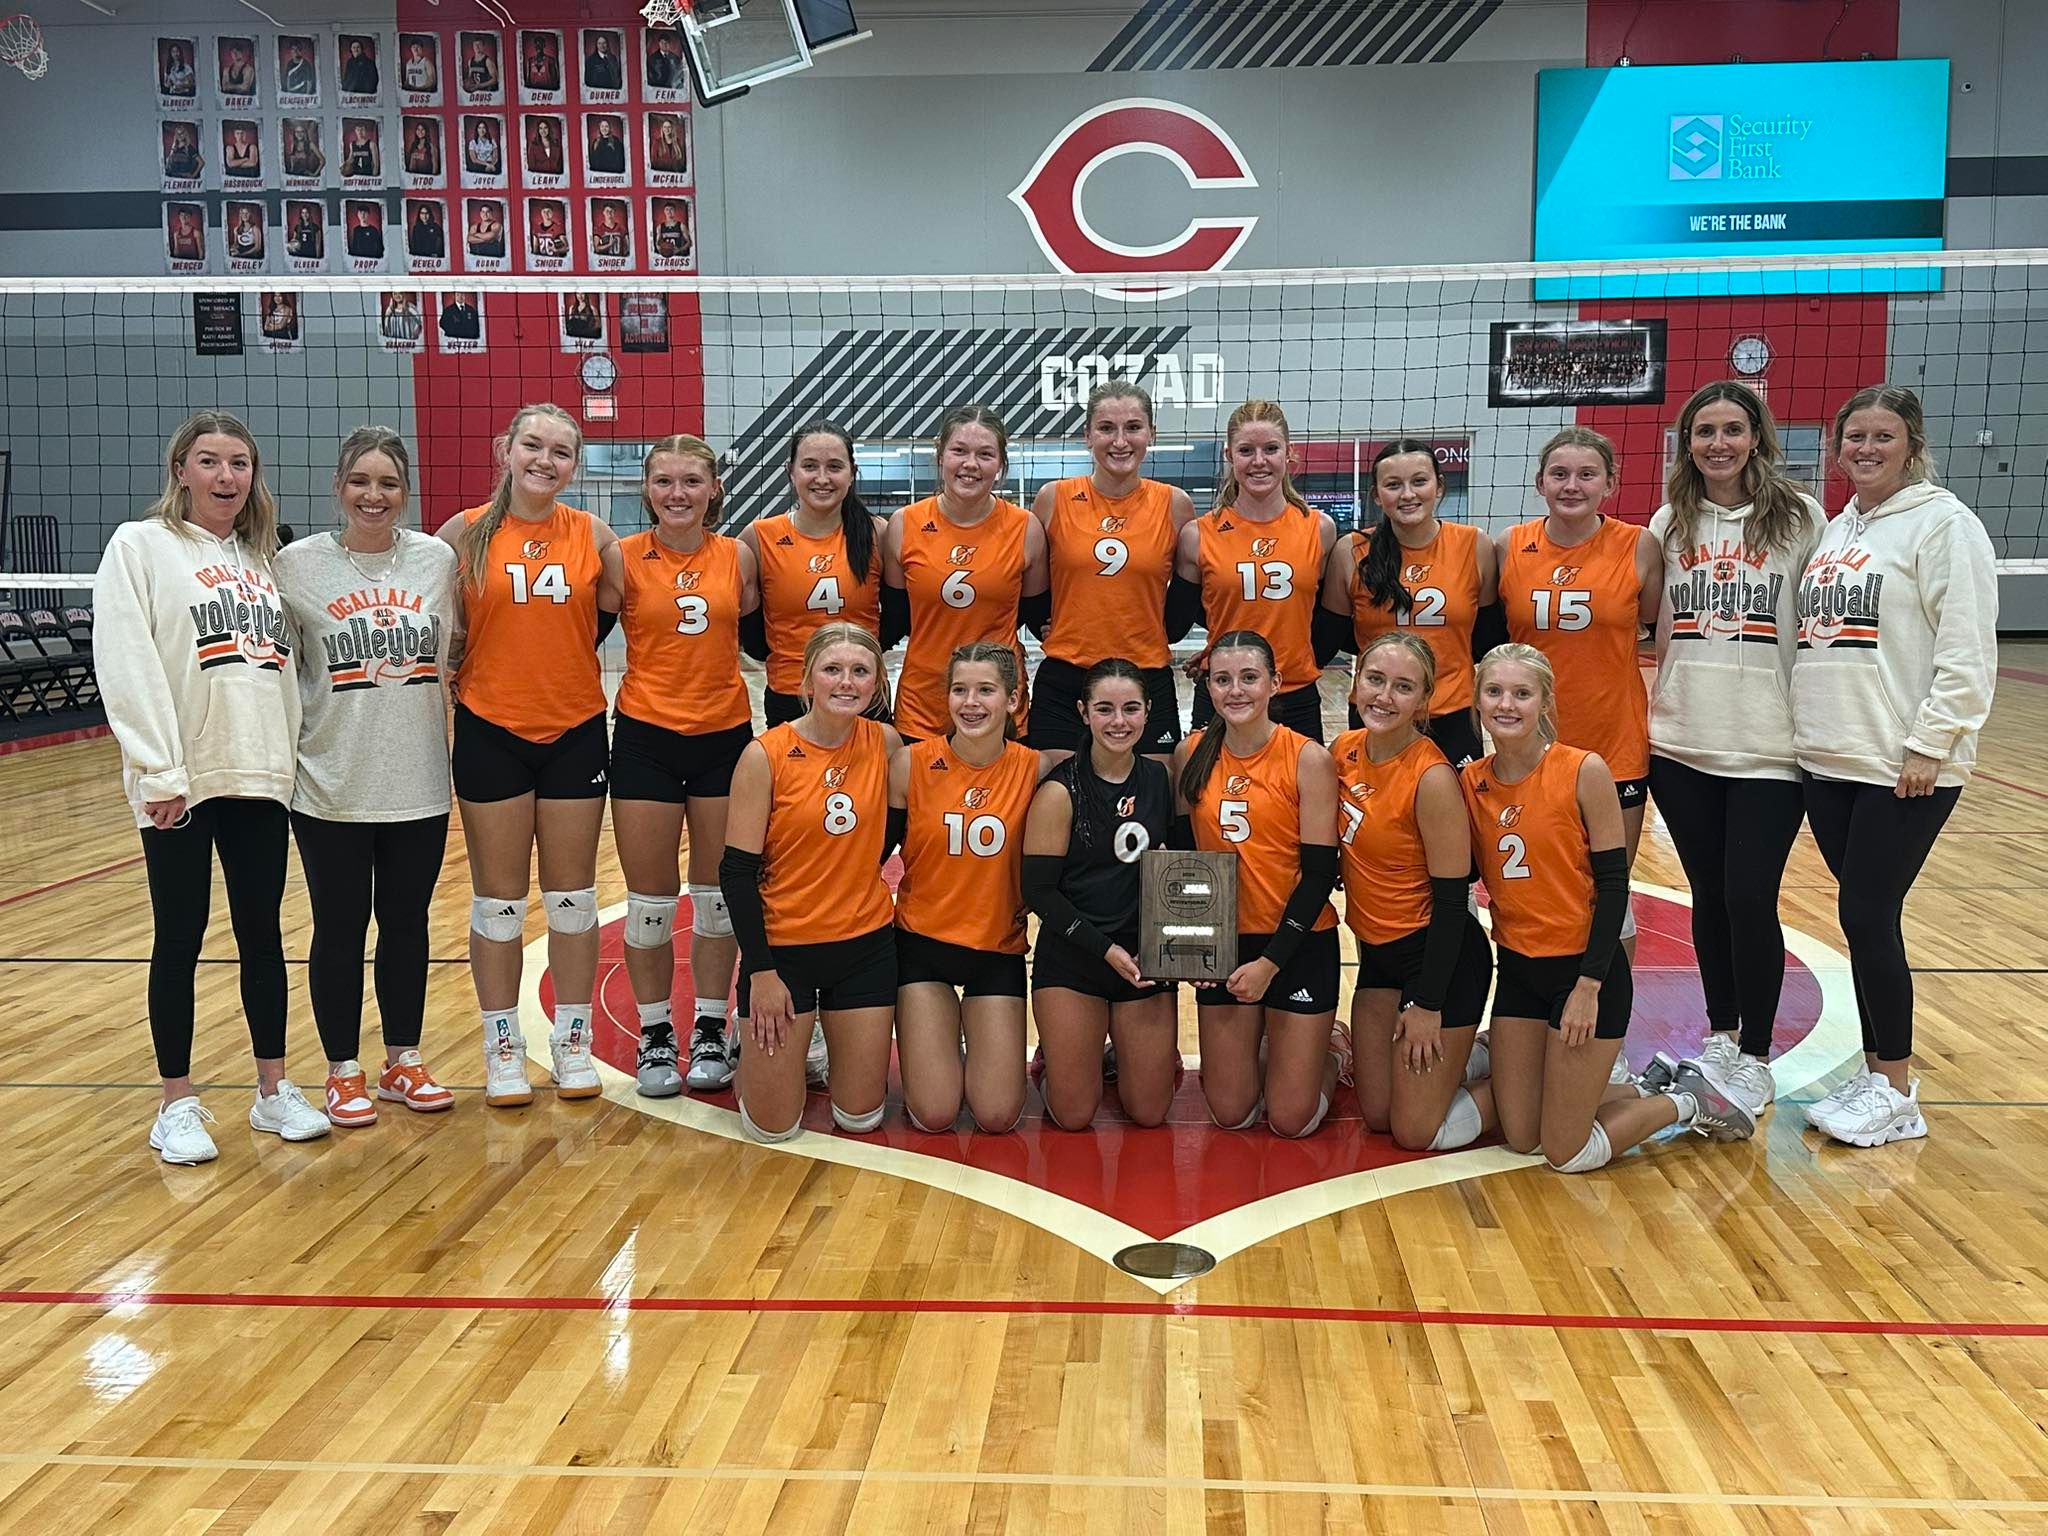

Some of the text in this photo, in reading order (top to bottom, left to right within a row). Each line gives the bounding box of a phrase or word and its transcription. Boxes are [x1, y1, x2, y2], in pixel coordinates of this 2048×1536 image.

[225, 97, 253, 106] BAKER
[408, 94, 431, 103] BUSS
[469, 93, 493, 102] DAVIS
[530, 92, 553, 101] DENG
[655, 90, 677, 100] FEIK
[162, 99, 195, 107] ALBRECHT
[1728, 114, 1814, 142] Security
[1728, 136, 1773, 158] First
[1728, 157, 1783, 180] Bank
[163, 180, 203, 189] FLEHARTY
[223, 179, 264, 189] HASBROUCK
[286, 178, 321, 187] HERNANDEZ
[343, 178, 383, 187] HOFFMASTER
[473, 176, 496, 185] JOYCE
[532, 175, 560, 185] LEAHY
[652, 174, 684, 184] MCFALL
[1007, 97, 1259, 302] C
[1690, 213, 1787, 232] WE'RE THE BANK
[171, 262, 203, 271] MERCED
[230, 260, 264, 270] NEGLEY
[353, 260, 379, 269] PROPP
[412, 259, 442, 268] REVELO
[535, 258, 564, 268] SNIDER
[598, 258, 627, 268] SNIDER
[654, 258, 691, 267] STRAUSS
[1040, 353, 1225, 411] COZAD
[1092, 536, 1129, 577] 9
[504, 562, 572, 604] 14
[1235, 560, 1294, 602] 13
[805, 576, 844, 615] 4
[940, 569, 976, 609] 6
[1669, 569, 1784, 622] volleyball
[327, 588, 423, 621] OGALLALA
[1530, 589, 1593, 631] 15
[375, 608, 391, 617] ALL
[674, 593, 709, 634] 3
[823, 791, 857, 836] 8
[1217, 800, 1251, 843] 5
[1339, 800, 1366, 846] 7
[942, 811, 1006, 857] 10
[1113, 821, 1151, 864] 0
[1497, 832, 1531, 879] 2
